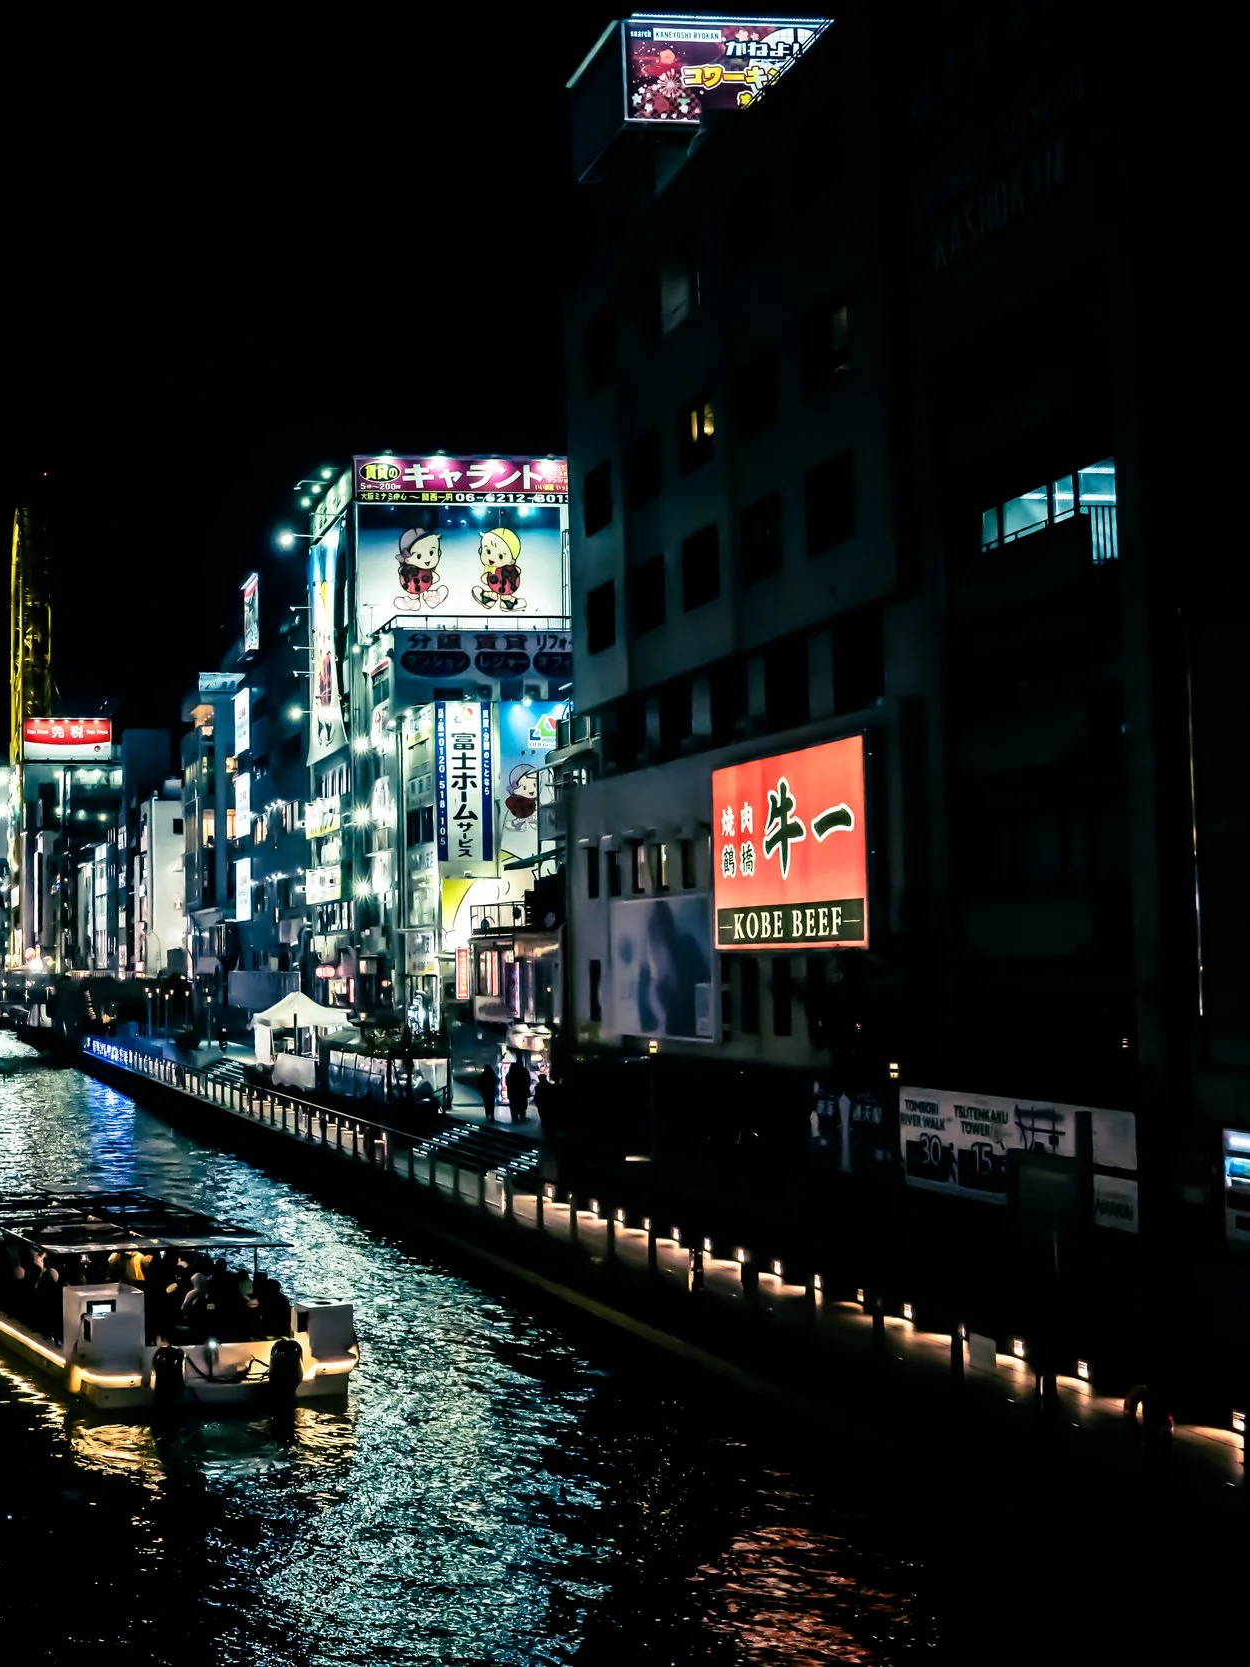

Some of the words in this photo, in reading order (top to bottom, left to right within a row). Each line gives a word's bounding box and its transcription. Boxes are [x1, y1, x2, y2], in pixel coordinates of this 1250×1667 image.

[630, 30, 652, 38] search
[655, 31, 692, 39] KANEYOSHI
[693, 32, 719, 40] RYOKAN
[402, 463, 544, 489] キャラント
[51, 725, 84, 739] 免税
[451, 732, 478, 857] 富士ホームサービス
[733, 910, 783, 939] KOBE
[791, 907, 843, 937] BEEF
[904, 1099, 939, 1115] TOMBORI
[954, 1105, 1009, 1125] TSUTENKAKU
[922, 1115, 946, 1131] WALK
[960, 1121, 991, 1137] TOWER
